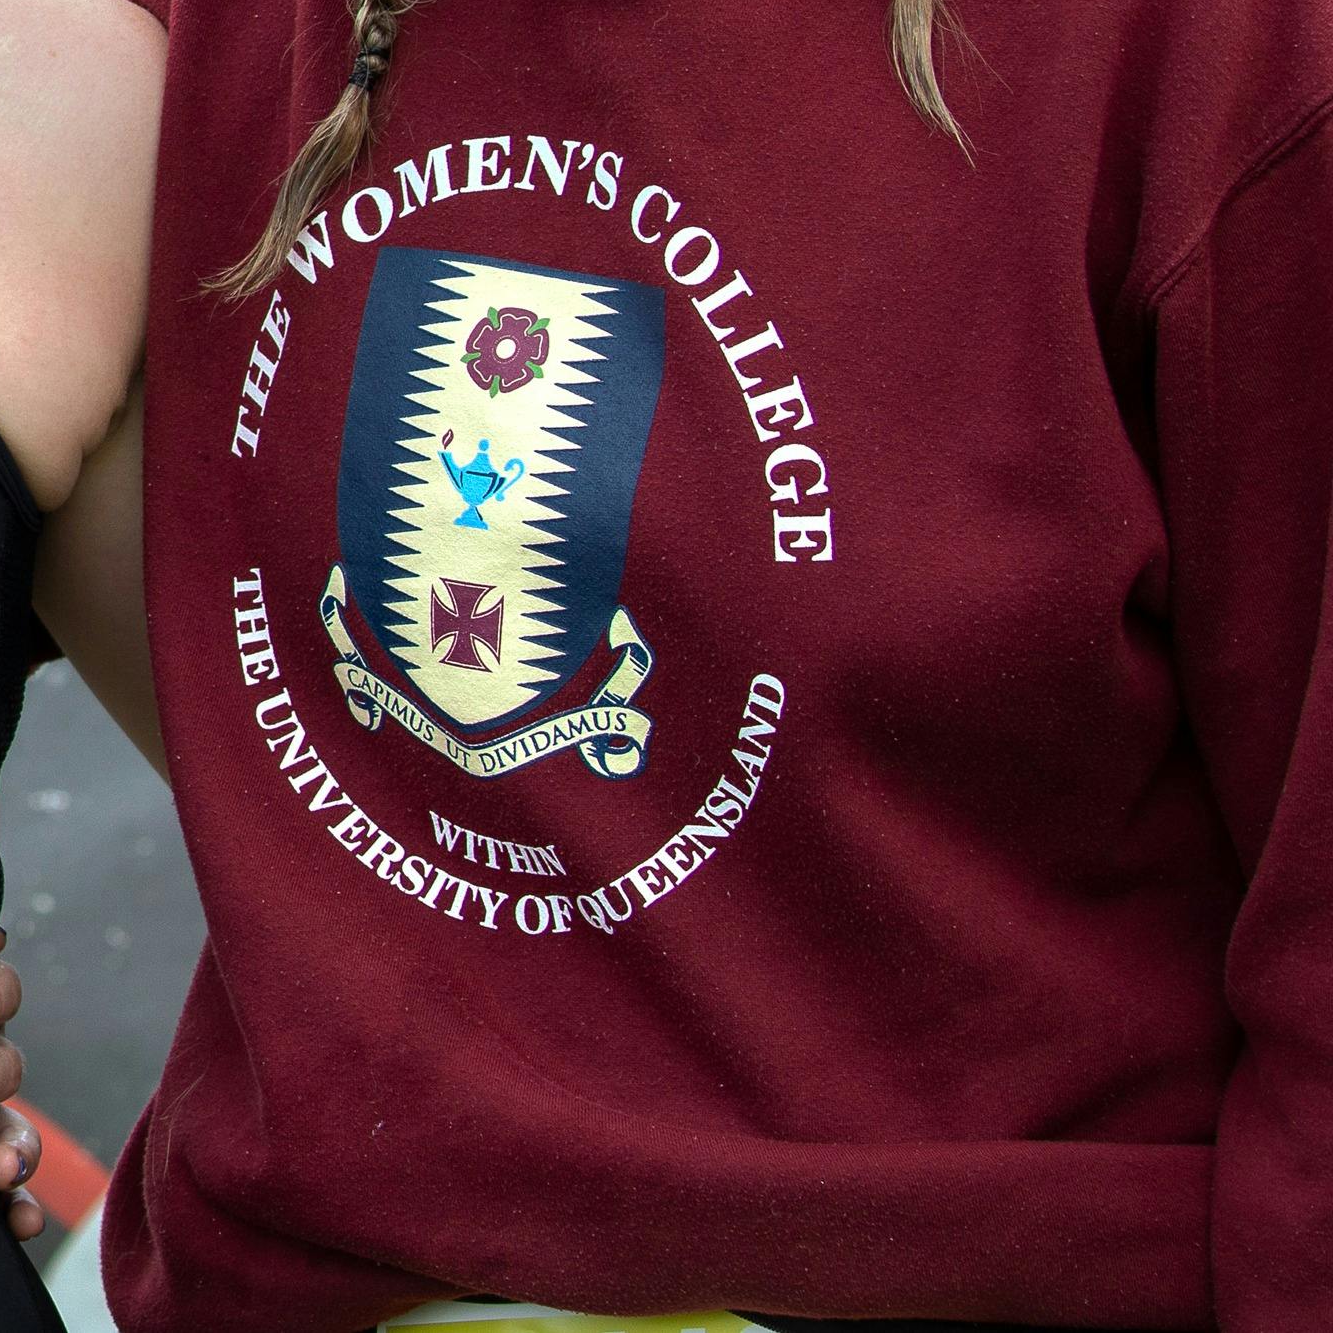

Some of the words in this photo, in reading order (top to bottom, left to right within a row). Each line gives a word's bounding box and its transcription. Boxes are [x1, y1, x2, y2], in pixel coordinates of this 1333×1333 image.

[231, 290, 291, 459] THE
[631, 184, 835, 564] COLLEGE
[233, 568, 279, 686] THE
[347, 668, 434, 742] CAPIMUS
[446, 739, 471, 769] UT
[478, 711, 627, 773] DIVIDAMUS
[255, 688, 510, 930] UNIVERSITY
[428, 811, 563, 876] WITHIN
[576, 672, 788, 933] QUEENSLAND
[515, 893, 576, 936] OF
